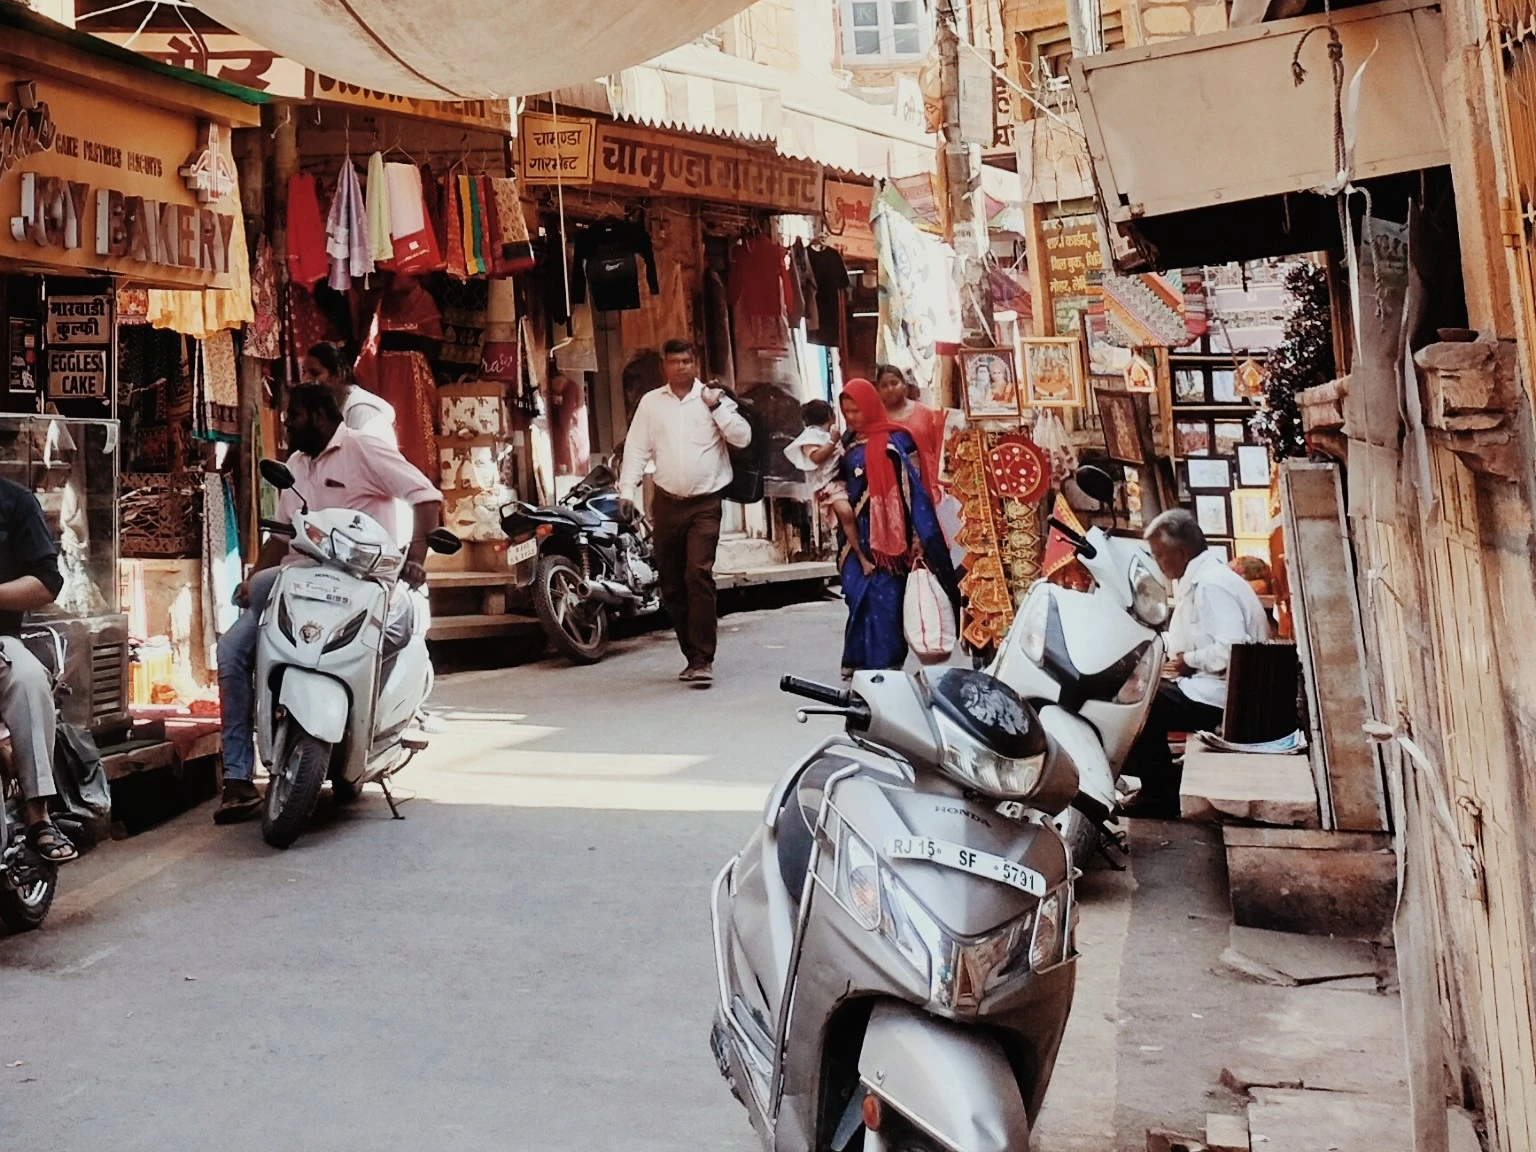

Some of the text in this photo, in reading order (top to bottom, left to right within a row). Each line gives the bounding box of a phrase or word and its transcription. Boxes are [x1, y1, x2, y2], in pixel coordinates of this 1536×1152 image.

[55, 134, 163, 178] CAKE PASTRIES BISCUITS
[602, 135, 713, 191] चामुण्डा
[10, 172, 235, 273] JOY BAKERY
[56, 317, 99, 340] कुल्फी
[62, 375, 96, 394] CAKE
[935, 805, 992, 828] HONDA
[959, 850, 977, 868] SF
[1002, 863, 1035, 890] 5791
